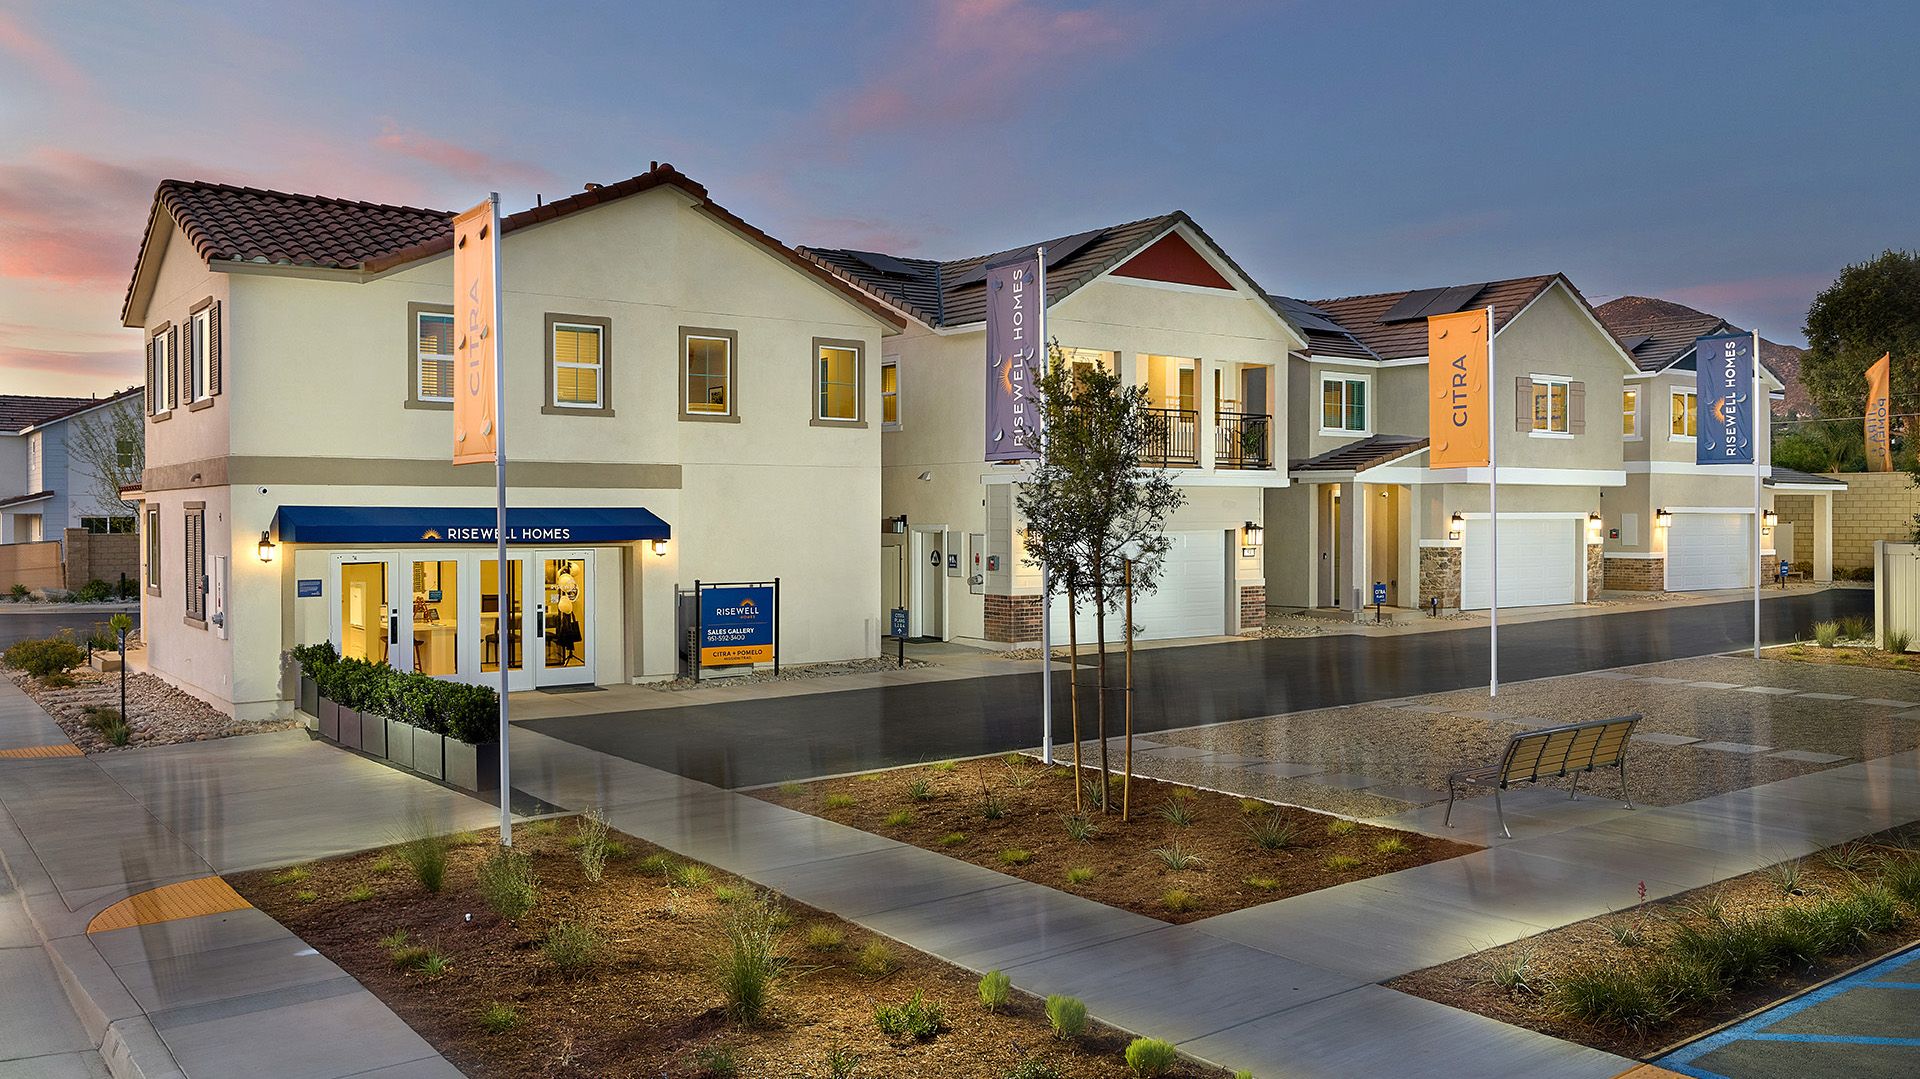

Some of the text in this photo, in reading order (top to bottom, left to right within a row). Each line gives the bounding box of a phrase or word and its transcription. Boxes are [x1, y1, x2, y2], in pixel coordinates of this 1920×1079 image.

[470, 279, 480, 397] CITRA
[1013, 269, 1024, 447] RISEWELL HOMES
[1452, 354, 1468, 427] CITRA
[1725, 341, 1737, 456] RISEWELL HOMES
[447, 528, 570, 540] RISEWEL HOMES
[716, 607, 759, 616] RISEWELL
